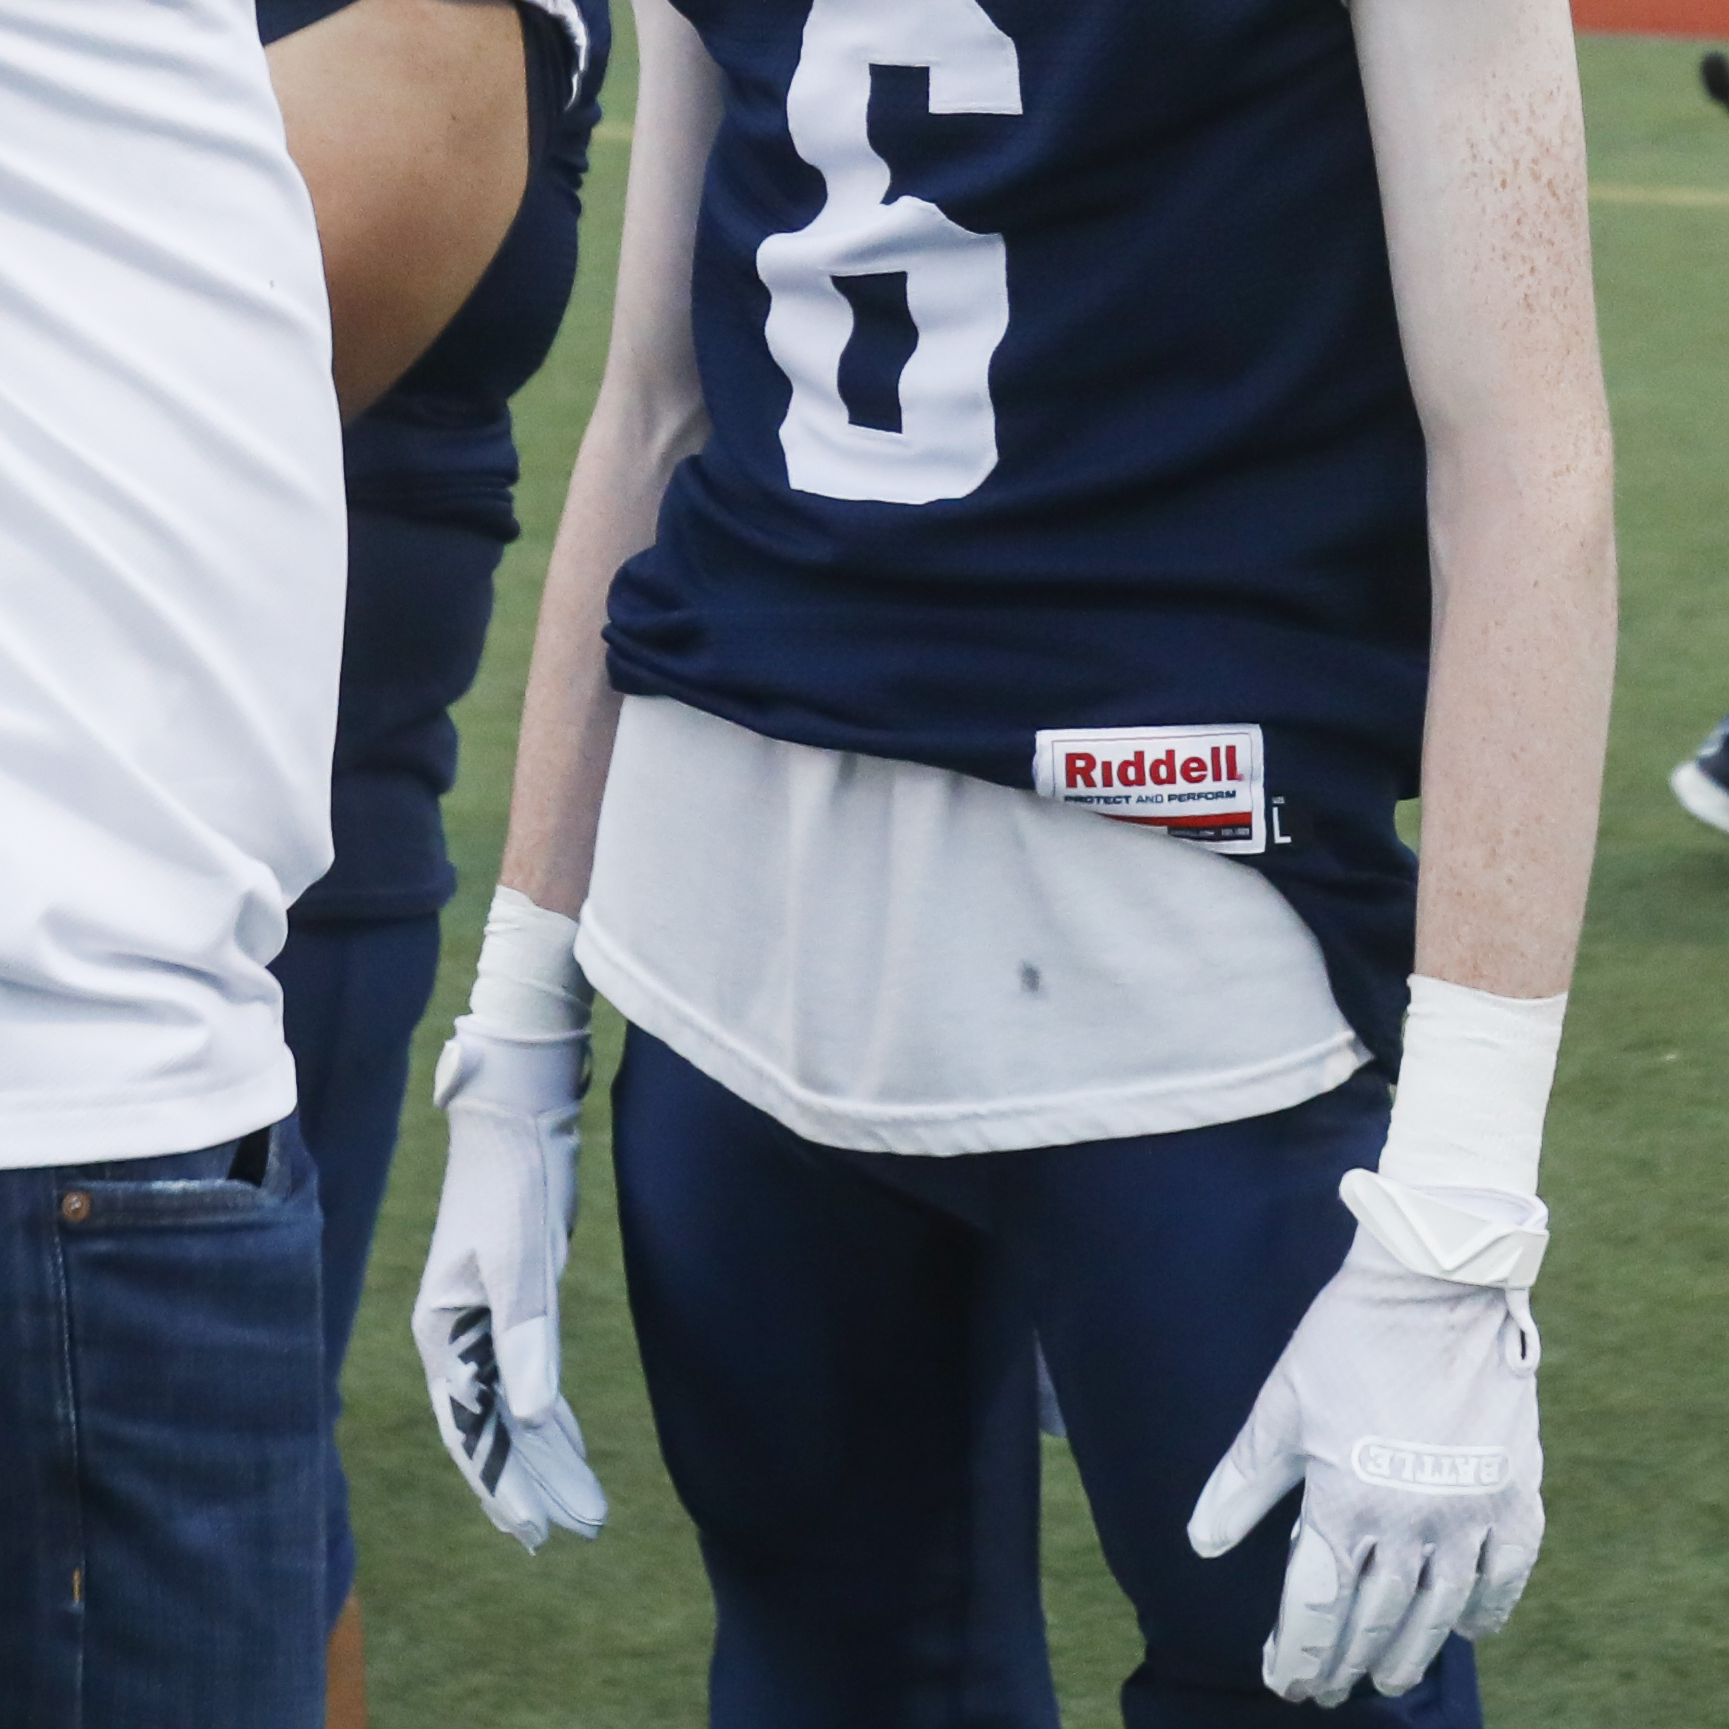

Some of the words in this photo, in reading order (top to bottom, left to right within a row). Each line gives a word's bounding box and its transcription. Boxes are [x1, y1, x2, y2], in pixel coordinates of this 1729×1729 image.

[1064, 745, 1239, 789] Riddell
[1136, 793, 1164, 804] AND
[1167, 790, 1237, 803] PERFORM
[1367, 1444, 1503, 1487] BATTLE
